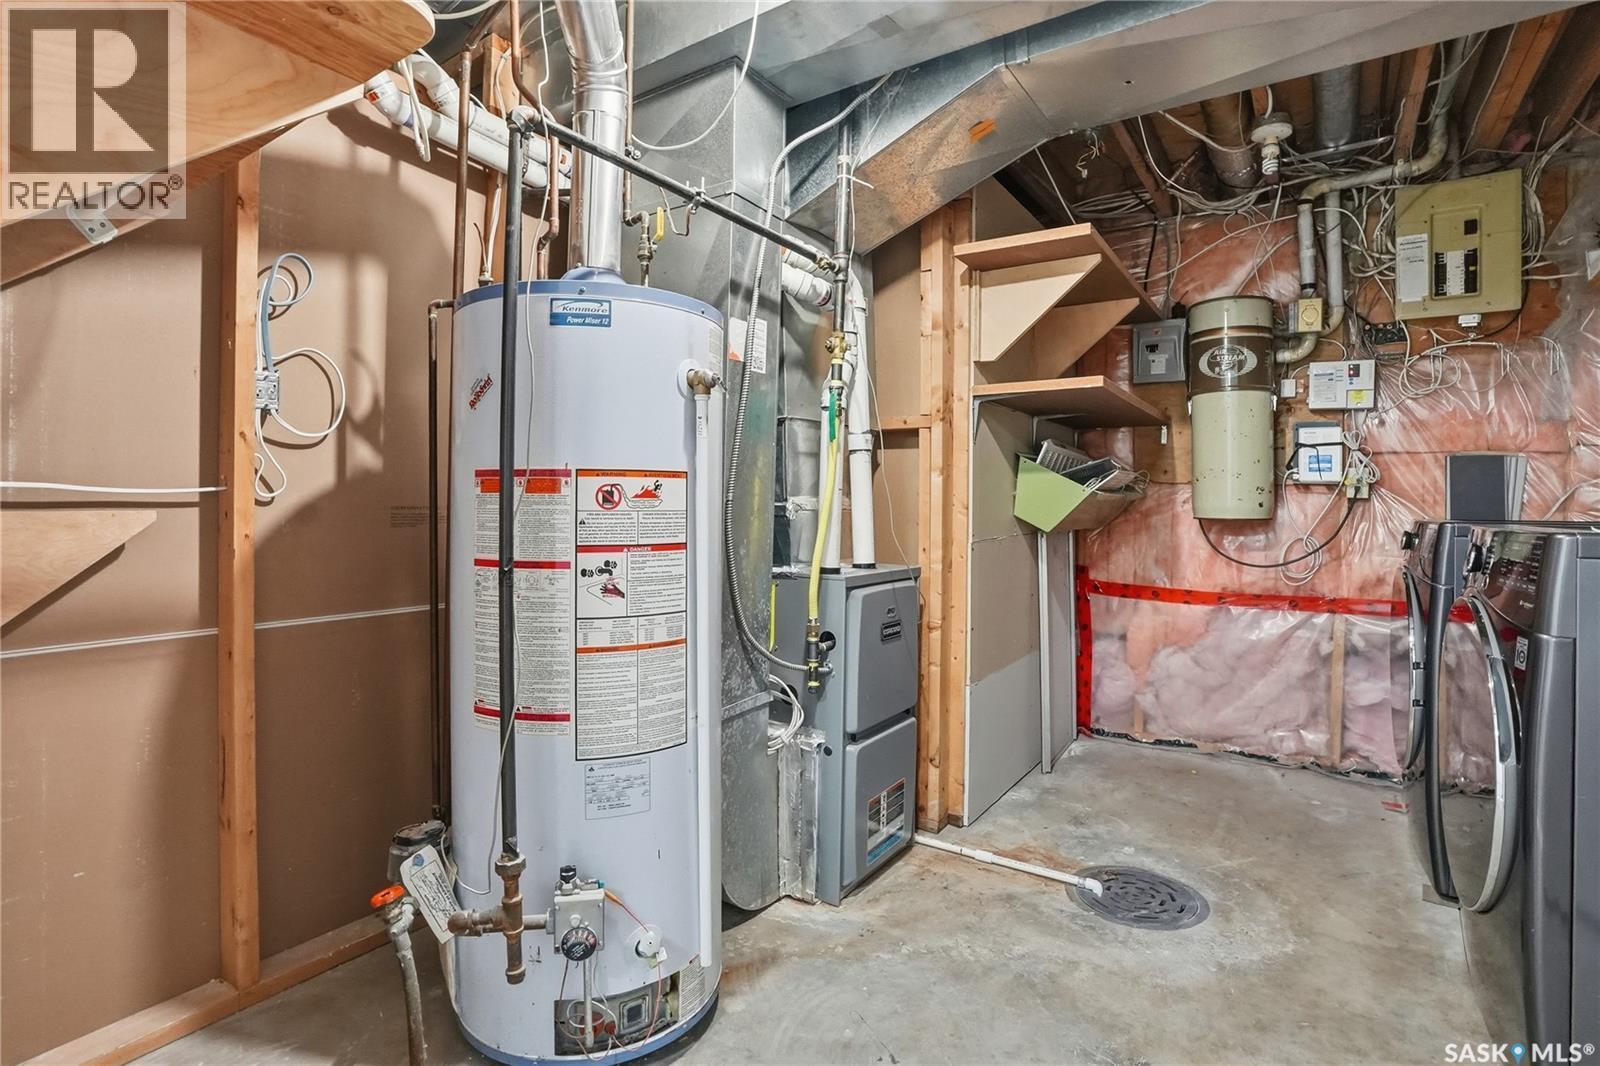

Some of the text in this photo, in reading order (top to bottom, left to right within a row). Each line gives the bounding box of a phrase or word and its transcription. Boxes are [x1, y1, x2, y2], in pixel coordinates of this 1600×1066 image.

[562, 305, 608, 313] Kenmore
[567, 315, 584, 324] Power
[585, 316, 601, 325] Miser
